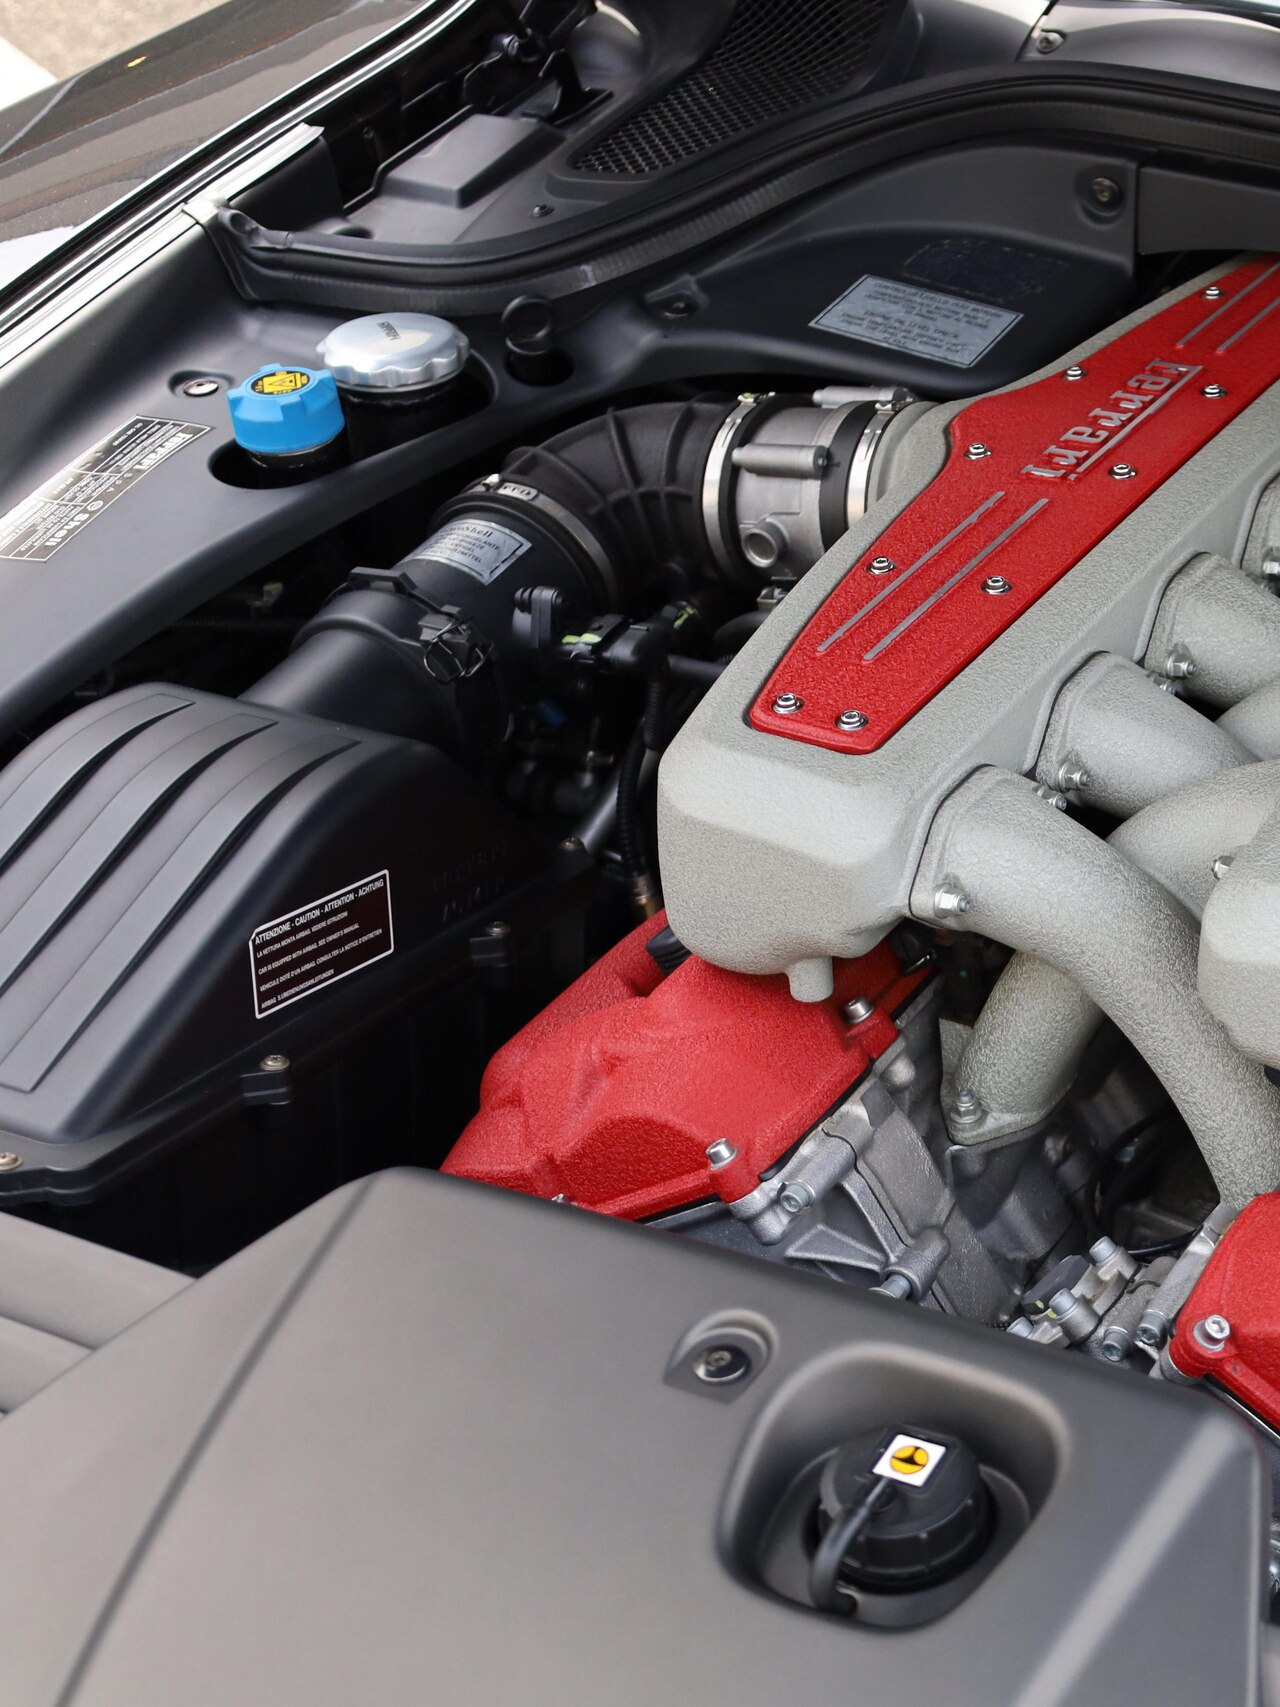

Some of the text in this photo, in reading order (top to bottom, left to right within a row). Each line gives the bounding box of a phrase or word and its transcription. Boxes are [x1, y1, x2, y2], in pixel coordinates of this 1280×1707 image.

[1020, 358, 1204, 481] Ferrari
[134, 432, 193, 471] Ferrari
[44, 513, 91, 546] Shell
[255, 921, 291, 944] ATTENZIONE
[295, 907, 320, 926] CAUTION
[324, 892, 354, 913] ATTENTION
[358, 878, 383, 897] ACHTUNG
[263, 943, 280, 955] VETTURA
[282, 936, 295, 946] MONTA
[272, 955, 291, 968] EQUIPPED
[293, 950, 302, 958] WITH
[326, 931, 343, 942] OWNER'S
[344, 923, 360, 934] MANUAL
[316, 949, 339, 964] CONSULTER
[345, 940, 358, 950] NOTICE
